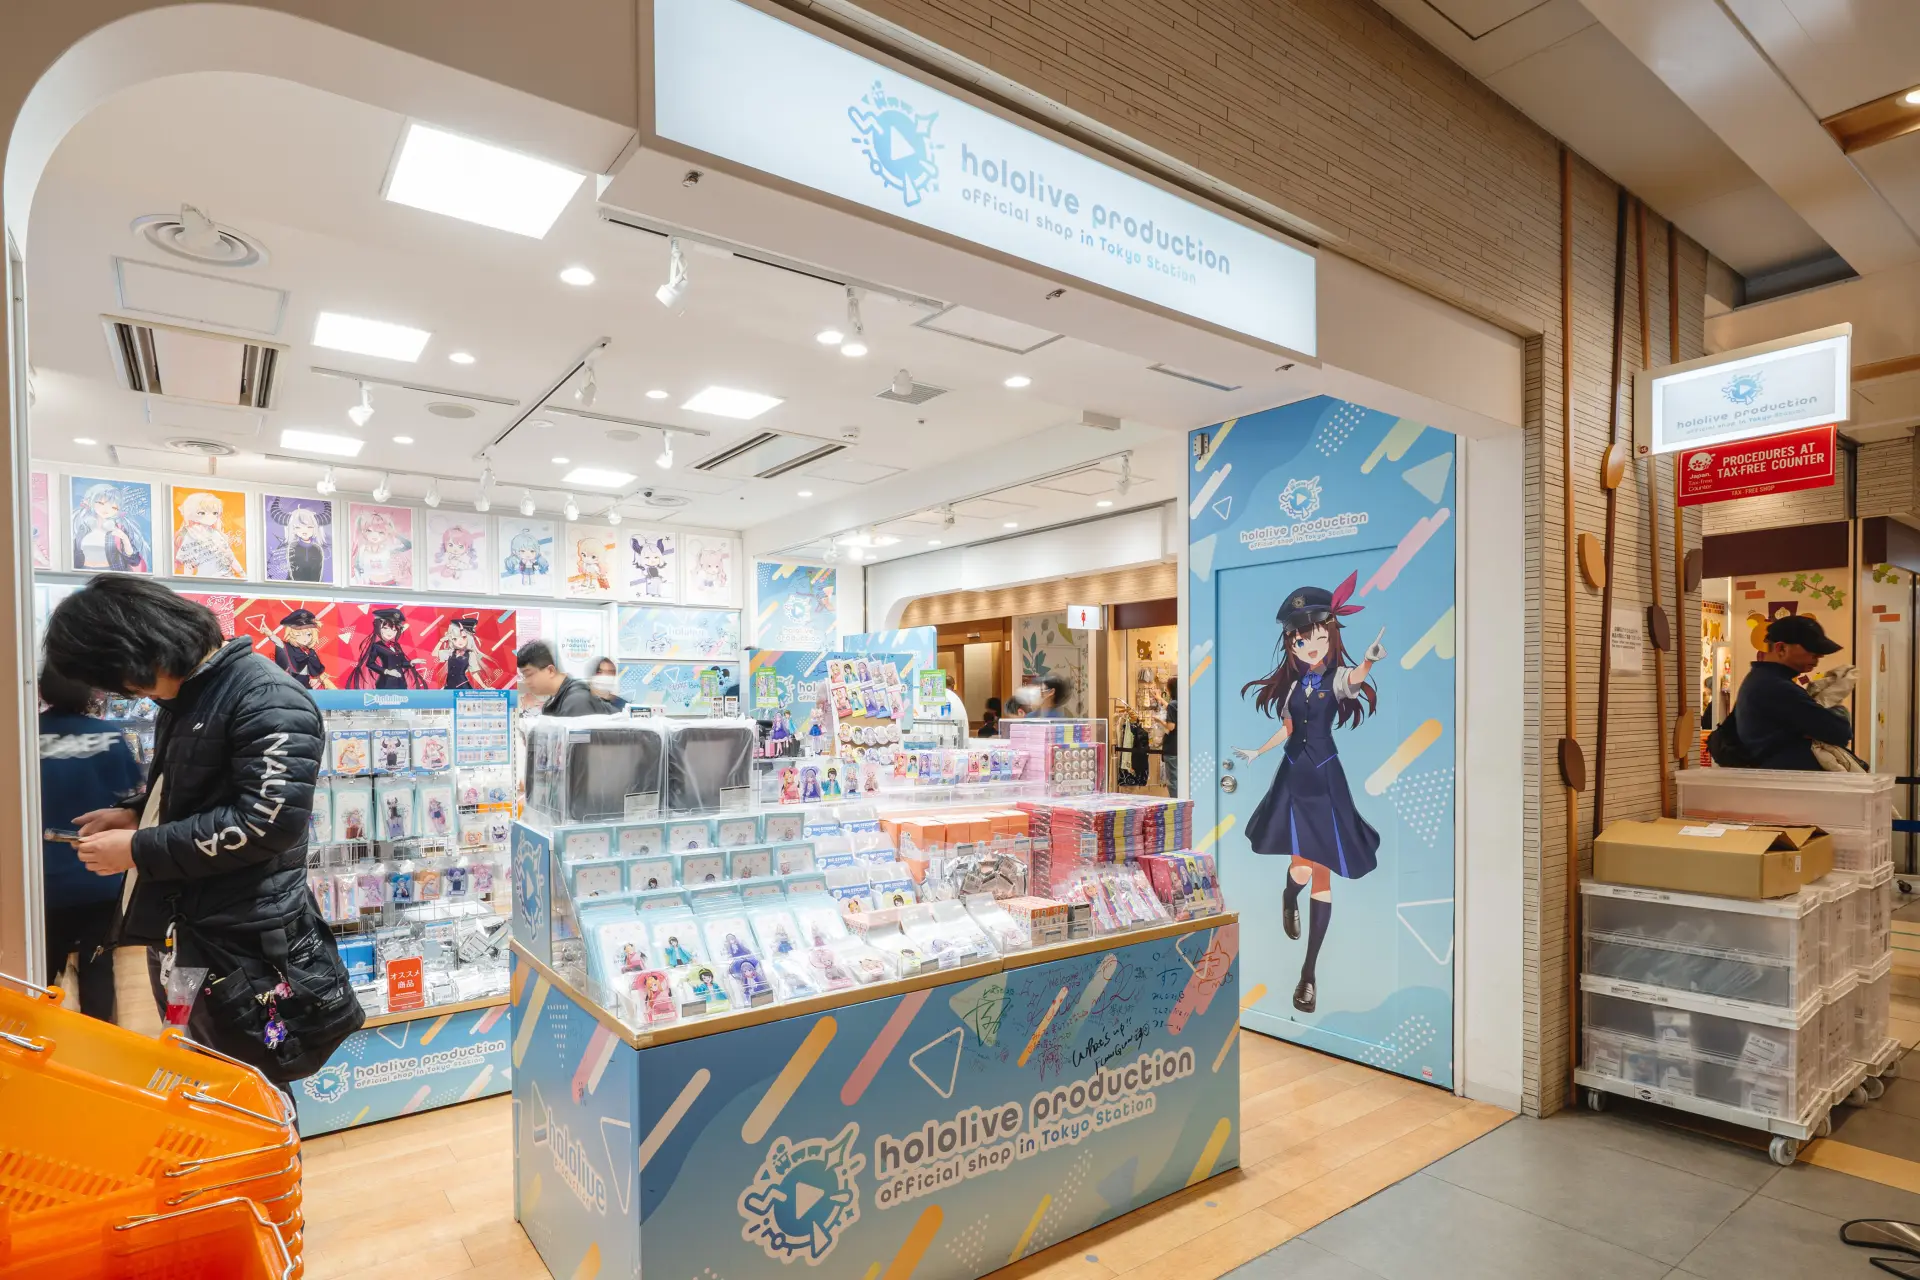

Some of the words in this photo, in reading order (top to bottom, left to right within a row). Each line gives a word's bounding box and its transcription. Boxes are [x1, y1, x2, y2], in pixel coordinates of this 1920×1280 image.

[961, 143, 1080, 214] hololive
[1092, 203, 1230, 275] production
[962, 188, 1029, 223] official
[1036, 214, 1073, 241] shop
[1080, 228, 1094, 247] in
[1099, 236, 1142, 265] Tokyo
[1146, 255, 1196, 285] Station
[1677, 412, 1728, 429] hololive
[1734, 396, 1818, 419] production
[1717, 462, 1766, 478] TAX-FREE
[1771, 453, 1825, 470] COUNTER
[1722, 446, 1795, 467] PROCEDURES
[1800, 442, 1816, 454] AT
[1689, 472, 1711, 480] Japan.
[1760, 485, 1775, 493] SHOP
[1241, 526, 1287, 541] hololive
[1292, 513, 1367, 534] production
[194, 732, 290, 857] NAUTICA
[390, 969, 420, 981] オススメ
[397, 979, 415, 990] 商品
[355, 1058, 416, 1078] hololive
[423, 1041, 505, 1065] production
[356, 1075, 390, 1087] official
[393, 1070, 413, 1080] shop
[426, 1063, 451, 1073] Tokyo
[880, 1107, 1019, 1173] hololive
[1033, 1050, 1192, 1128] production
[548, 1108, 605, 1210] hololive
[880, 1161, 960, 1203] official
[968, 1146, 1011, 1172] shop
[1020, 1138, 1035, 1154] in
[1041, 1119, 1090, 1145] Tokyo
[1096, 1097, 1153, 1126] Station
